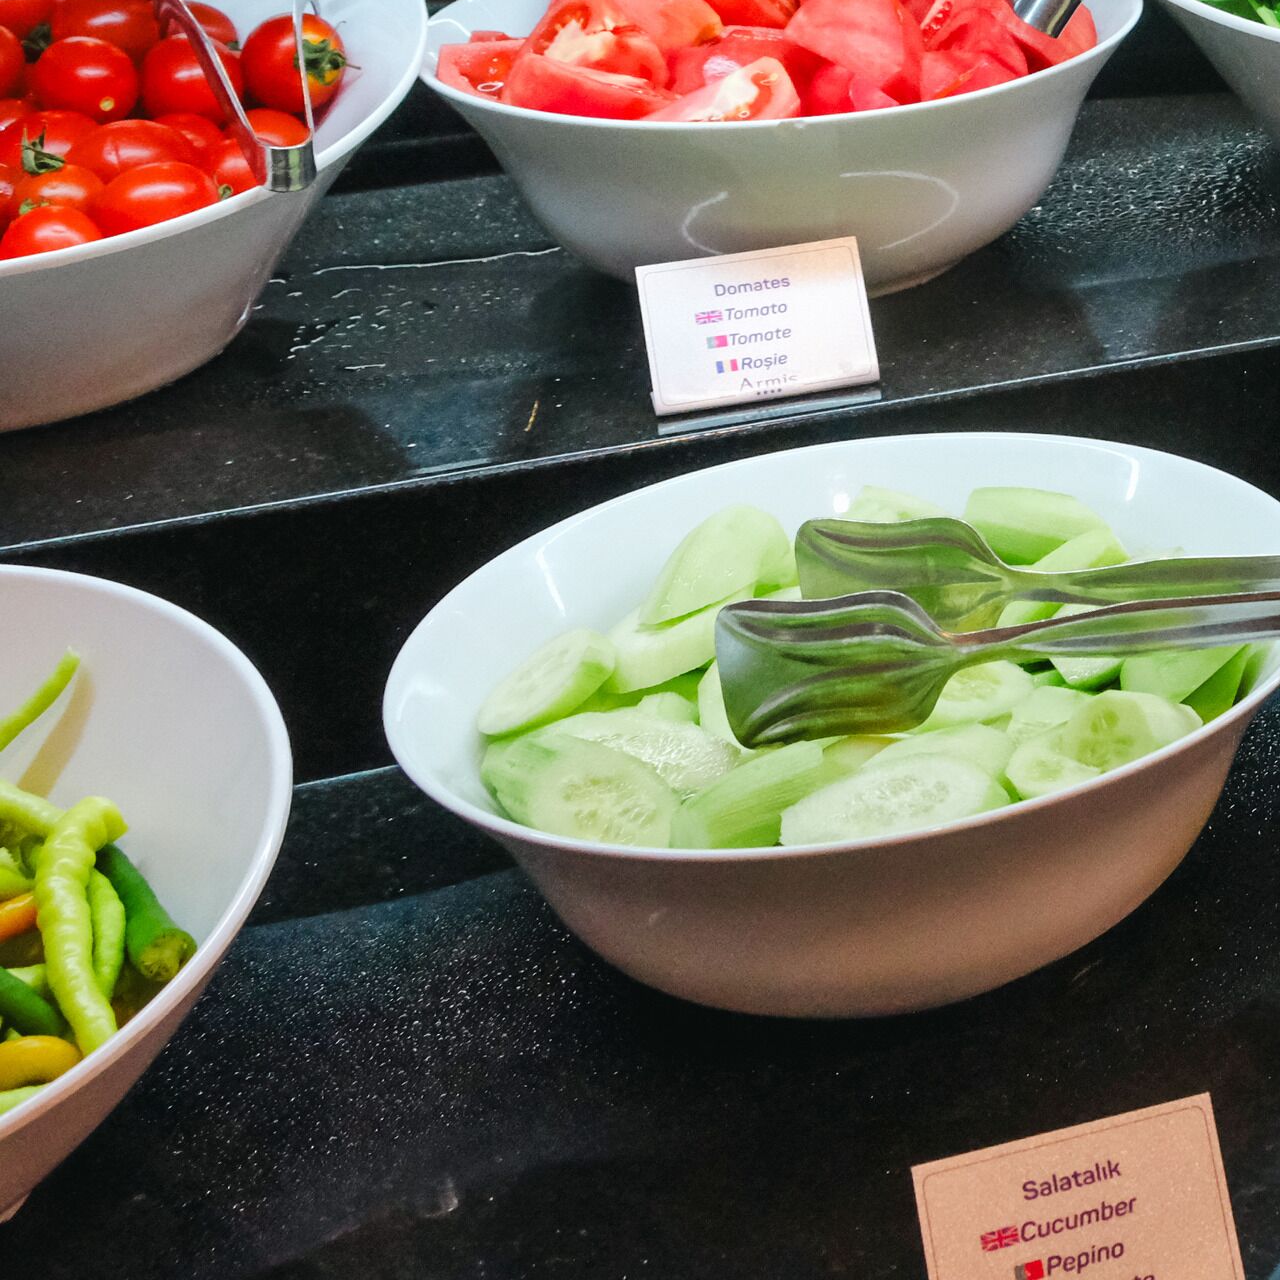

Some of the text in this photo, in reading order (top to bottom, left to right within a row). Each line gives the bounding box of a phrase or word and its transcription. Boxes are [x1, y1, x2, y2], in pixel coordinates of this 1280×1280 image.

[714, 277, 791, 297] Domates
[725, 302, 788, 321] Tomato
[729, 327, 792, 347] Tomate
[739, 374, 798, 392] Armis
[1022, 1159, 1122, 1200] Salatalık
[1020, 1197, 1137, 1242] Cucumber
[1046, 1241, 1124, 1275] Pepino
